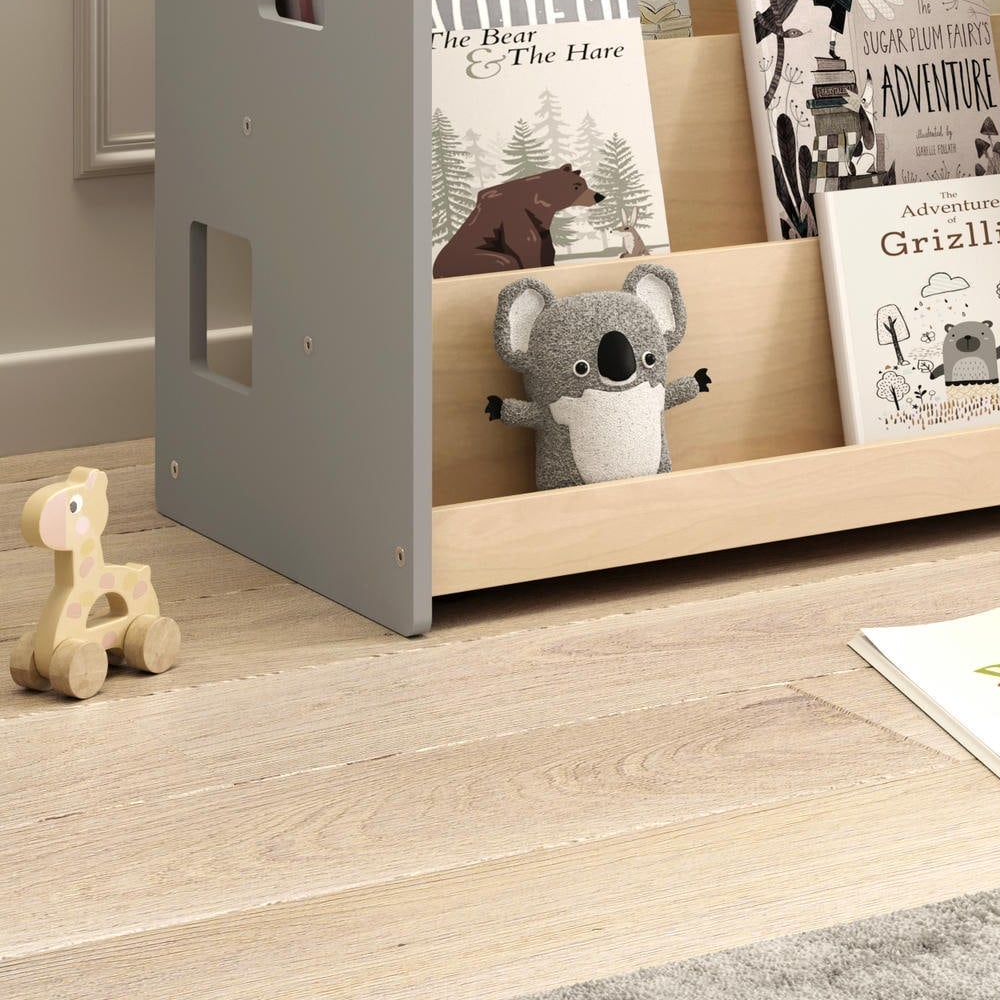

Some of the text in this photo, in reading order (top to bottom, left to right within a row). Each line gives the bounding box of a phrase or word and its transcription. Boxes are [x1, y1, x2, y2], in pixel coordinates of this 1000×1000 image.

[432, 28, 538, 50] The Bear
[863, 21, 991, 55] SUGAR PLUM FAIRY'S
[465, 42, 625, 80] & The Hare
[881, 58, 998, 117] ADVENTURE
[939, 191, 958, 199] The
[901, 198, 1000, 219] Adventure
[947, 216, 957, 224] of
